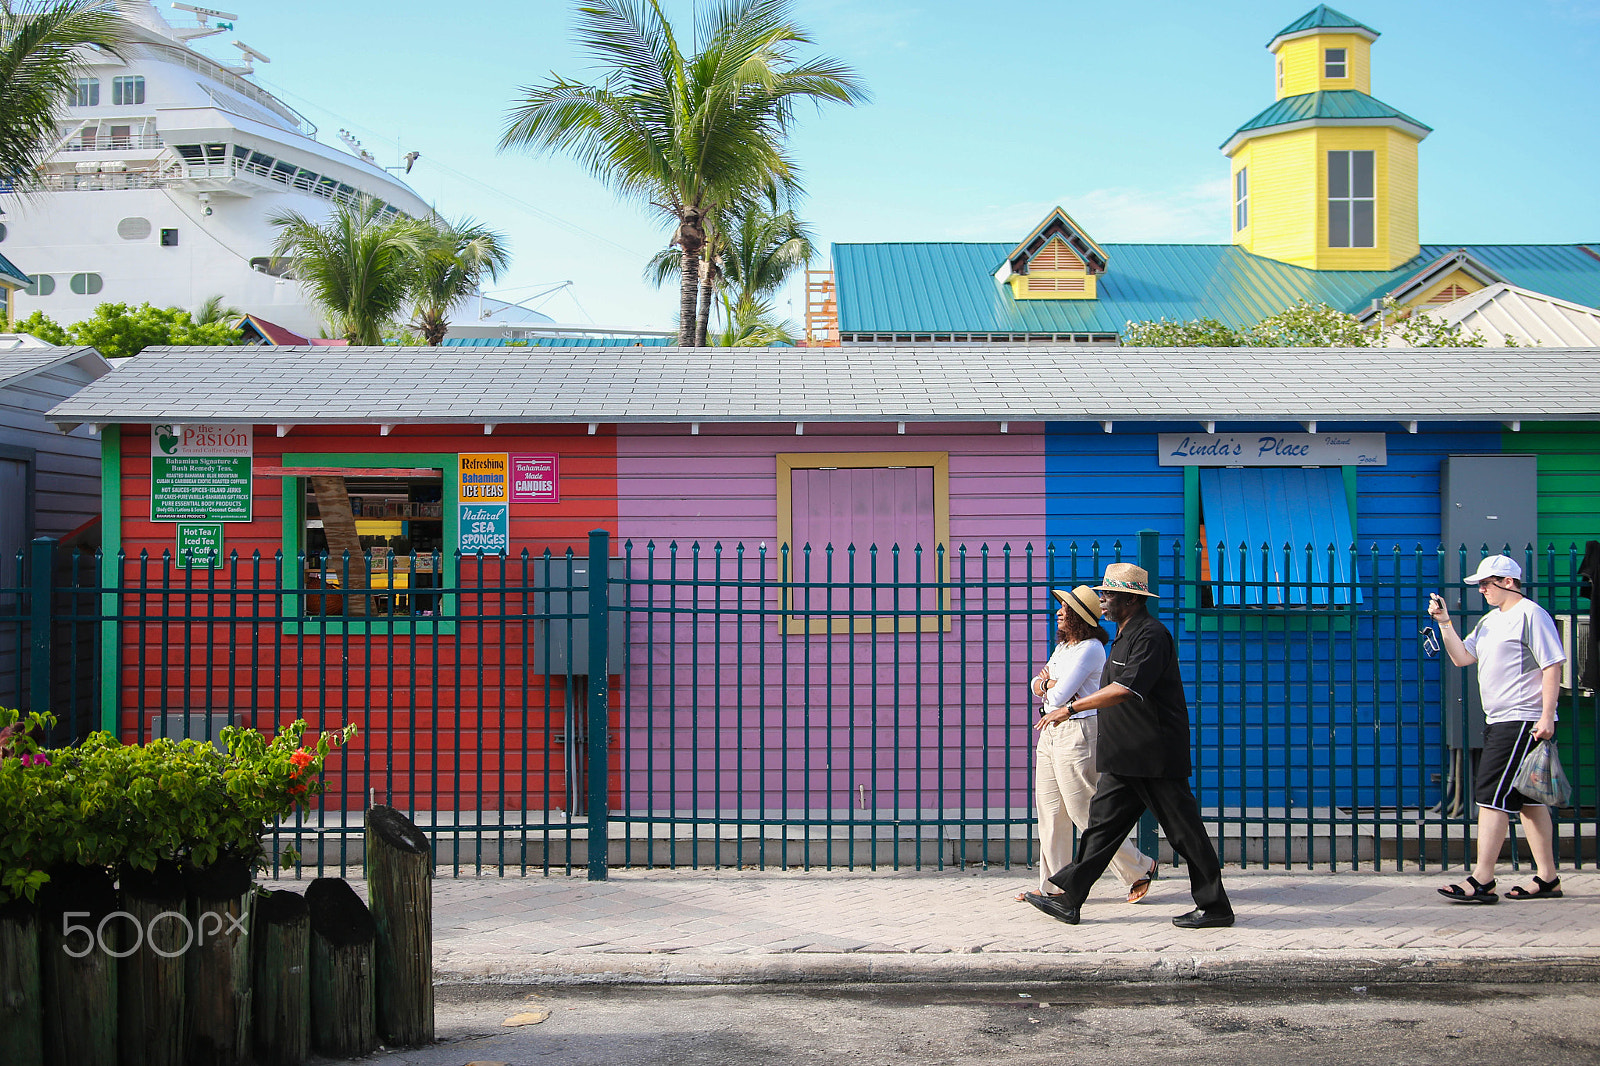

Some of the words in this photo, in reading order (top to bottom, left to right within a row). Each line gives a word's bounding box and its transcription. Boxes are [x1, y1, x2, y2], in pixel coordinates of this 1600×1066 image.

[198, 425, 213, 433] the
[183, 428, 248, 446] Pasión
[1171, 436, 1242, 457] Linda's
[1258, 436, 1309, 458] Place
[1325, 437, 1351, 445] Island
[462, 458, 504, 471] Refreshing
[1358, 455, 1377, 464] Food
[462, 473, 504, 483] Bahamian
[462, 485, 478, 497] ICE
[480, 485, 504, 497] TEAS
[515, 481, 553, 492] CANDIES
[462, 507, 505, 520] Natural
[183, 528, 197, 536] Hot
[199, 528, 211, 536] Tea
[471, 522, 495, 533] SEA
[462, 534, 505, 545] SPONGES
